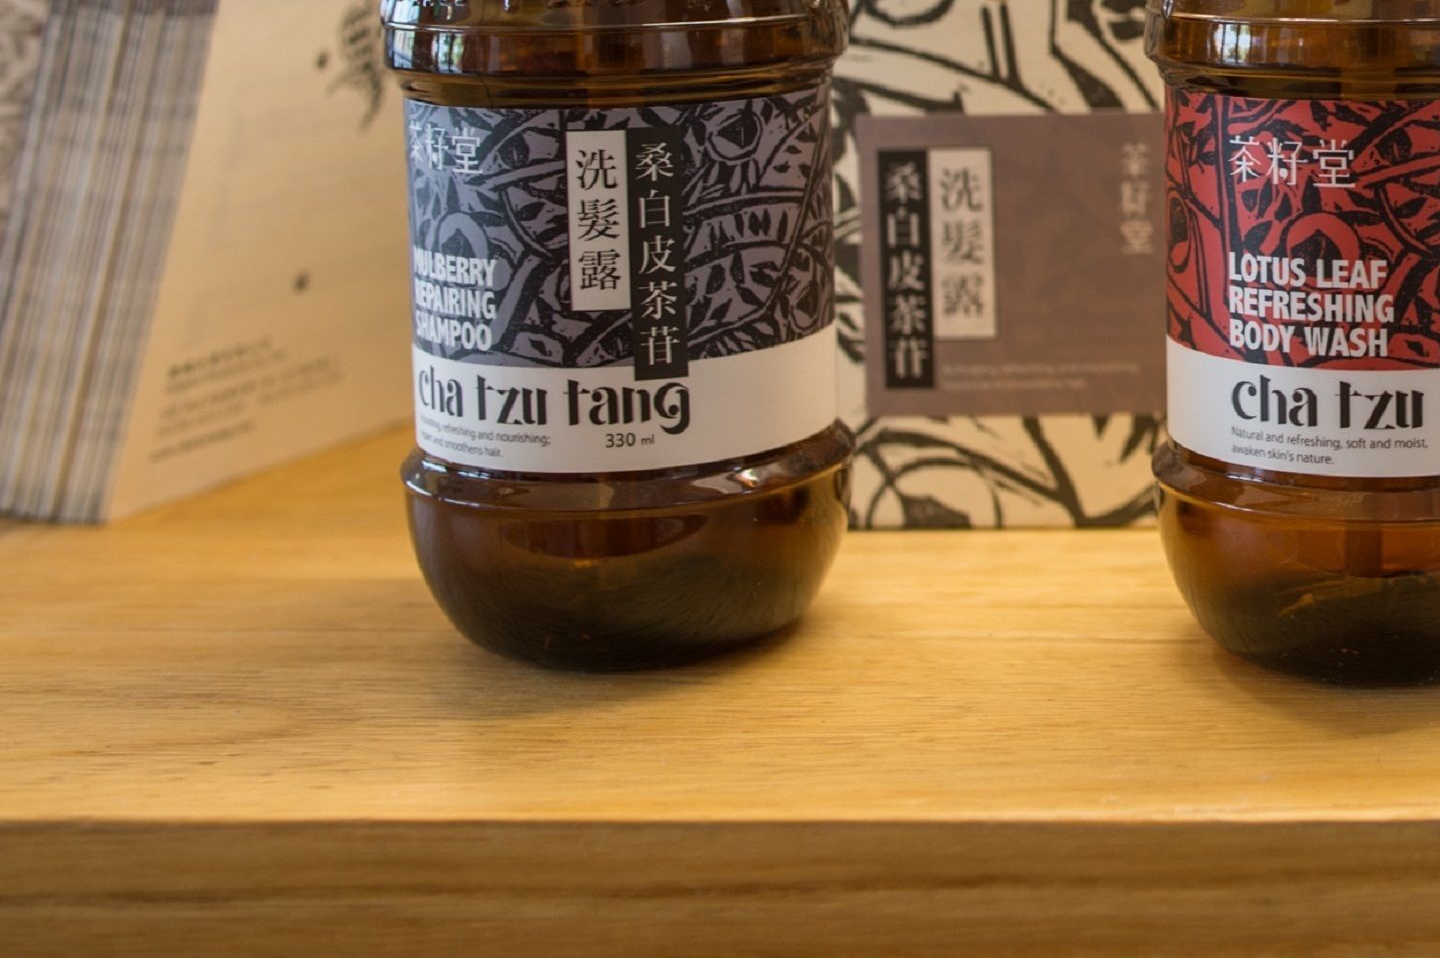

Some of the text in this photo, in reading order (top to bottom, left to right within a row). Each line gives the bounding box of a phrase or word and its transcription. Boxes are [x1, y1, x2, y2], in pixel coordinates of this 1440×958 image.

[1228, 135, 1356, 188] 茶籽堂
[576, 149, 621, 291] 洗髮露
[635, 142, 680, 366] 桑白皮茶苷
[1229, 251, 1387, 289] LOTUS LEAF
[1229, 285, 1394, 323] REFRESHING
[416, 309, 492, 351] SHAMPOO
[1229, 318, 1388, 357] BODY WASH
[419, 365, 690, 435] cha tzu tang
[1231, 374, 1318, 428] cha
[1335, 380, 1424, 430] tzu
[605, 433, 655, 449] 330 ml
[1231, 425, 1264, 441] Natural
[1265, 433, 1284, 444] and
[1286, 434, 1343, 451] refreshing,
[1346, 438, 1367, 449] soft
[1369, 438, 1391, 449] and
[1231, 444, 1335, 465] awaken skin's nature.
